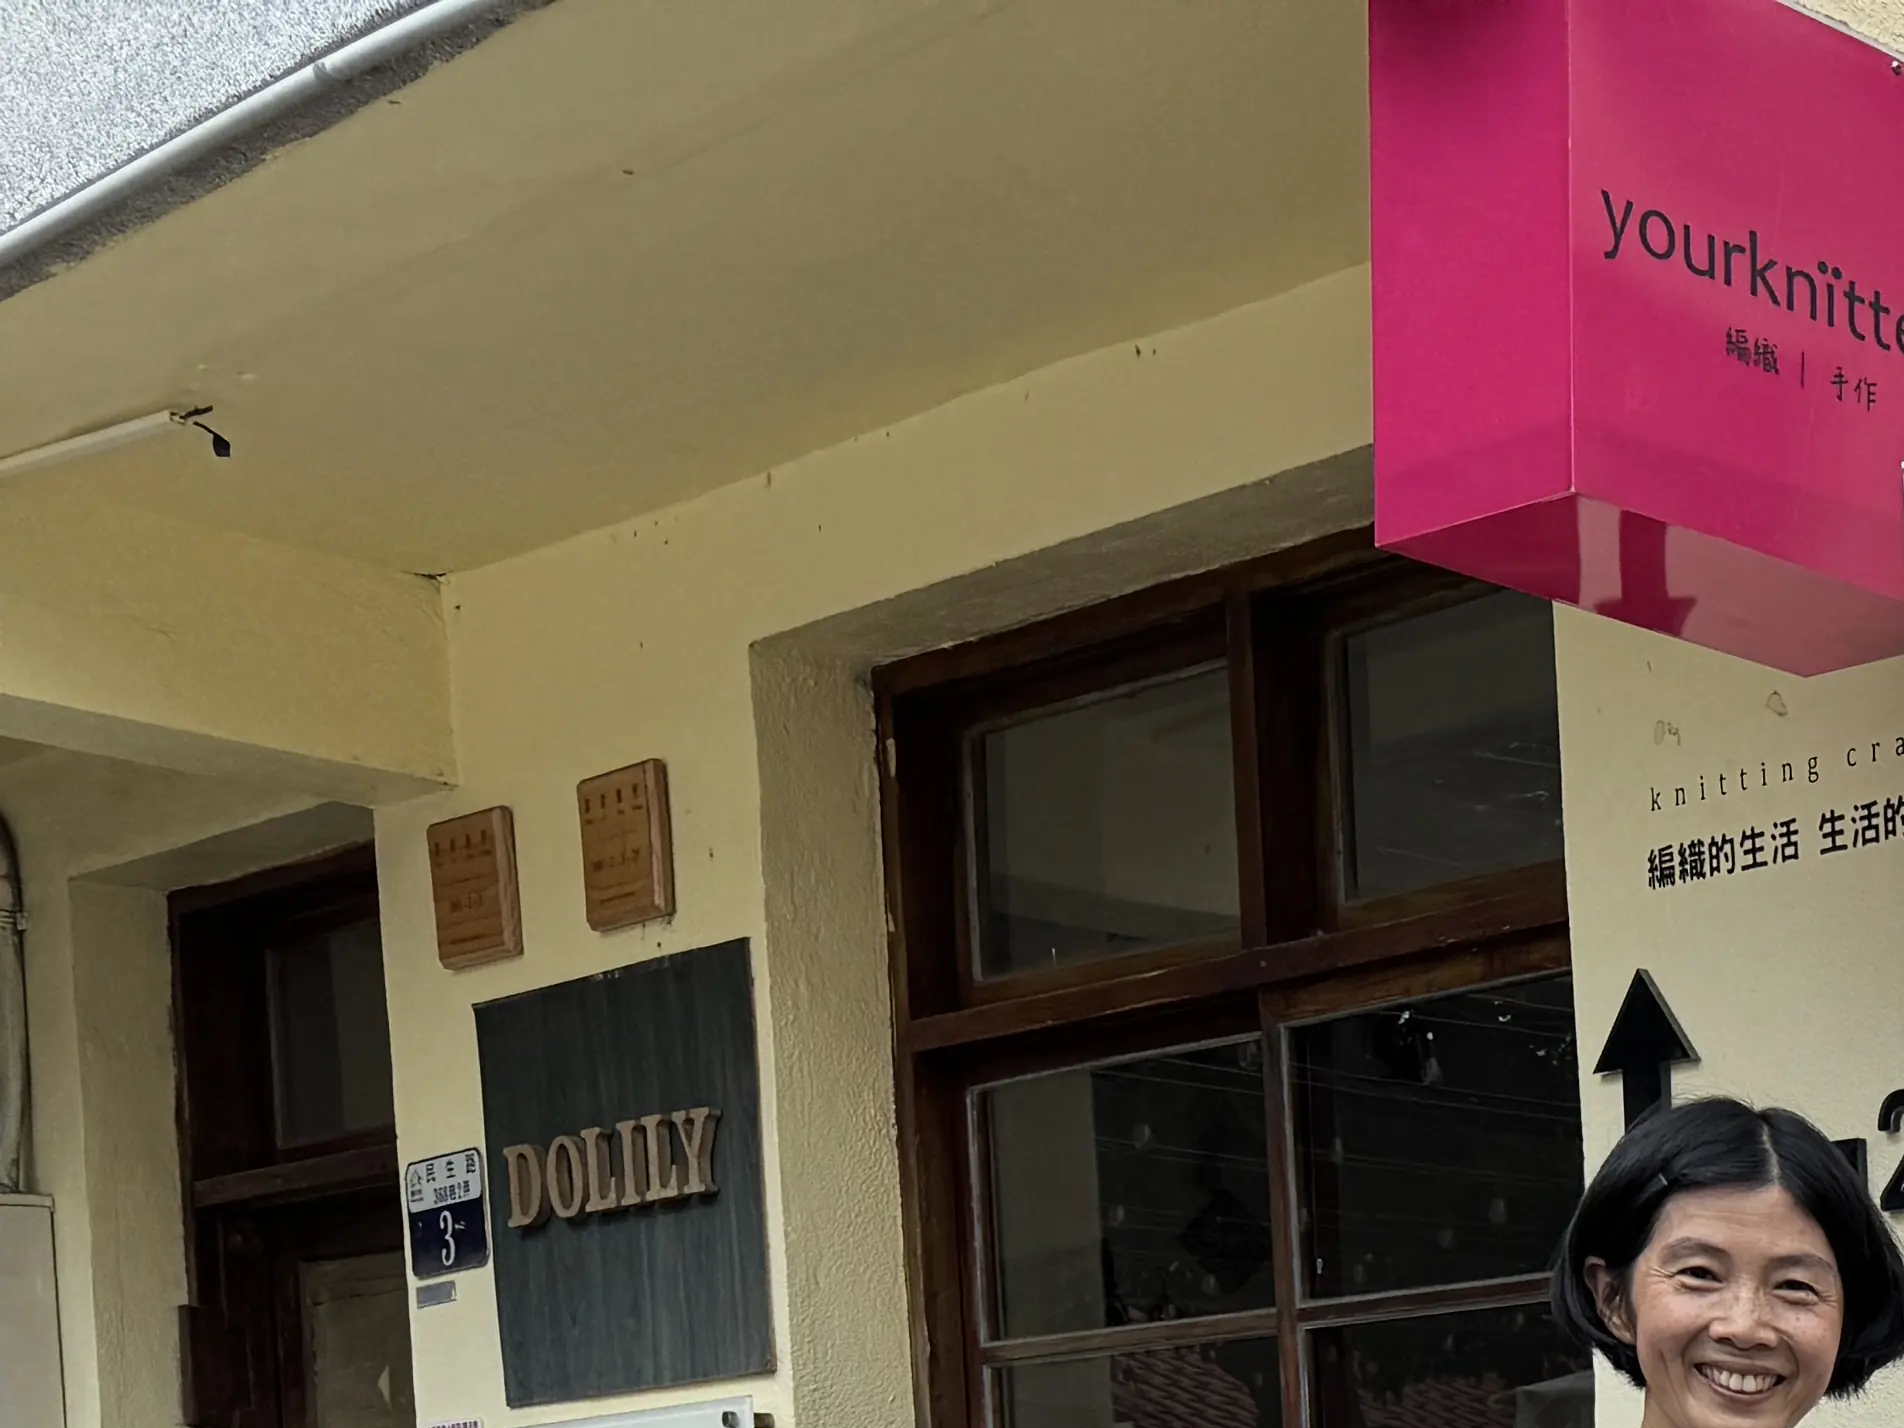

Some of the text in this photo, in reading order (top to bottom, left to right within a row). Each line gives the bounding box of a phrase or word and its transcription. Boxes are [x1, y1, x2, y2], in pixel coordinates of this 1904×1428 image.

[1725, 326, 1878, 412] 編織 手作
[1650, 755, 1820, 812] knitting
[1647, 817, 1800, 890] 編織的生活
[502, 1106, 724, 1230] DOLILY
